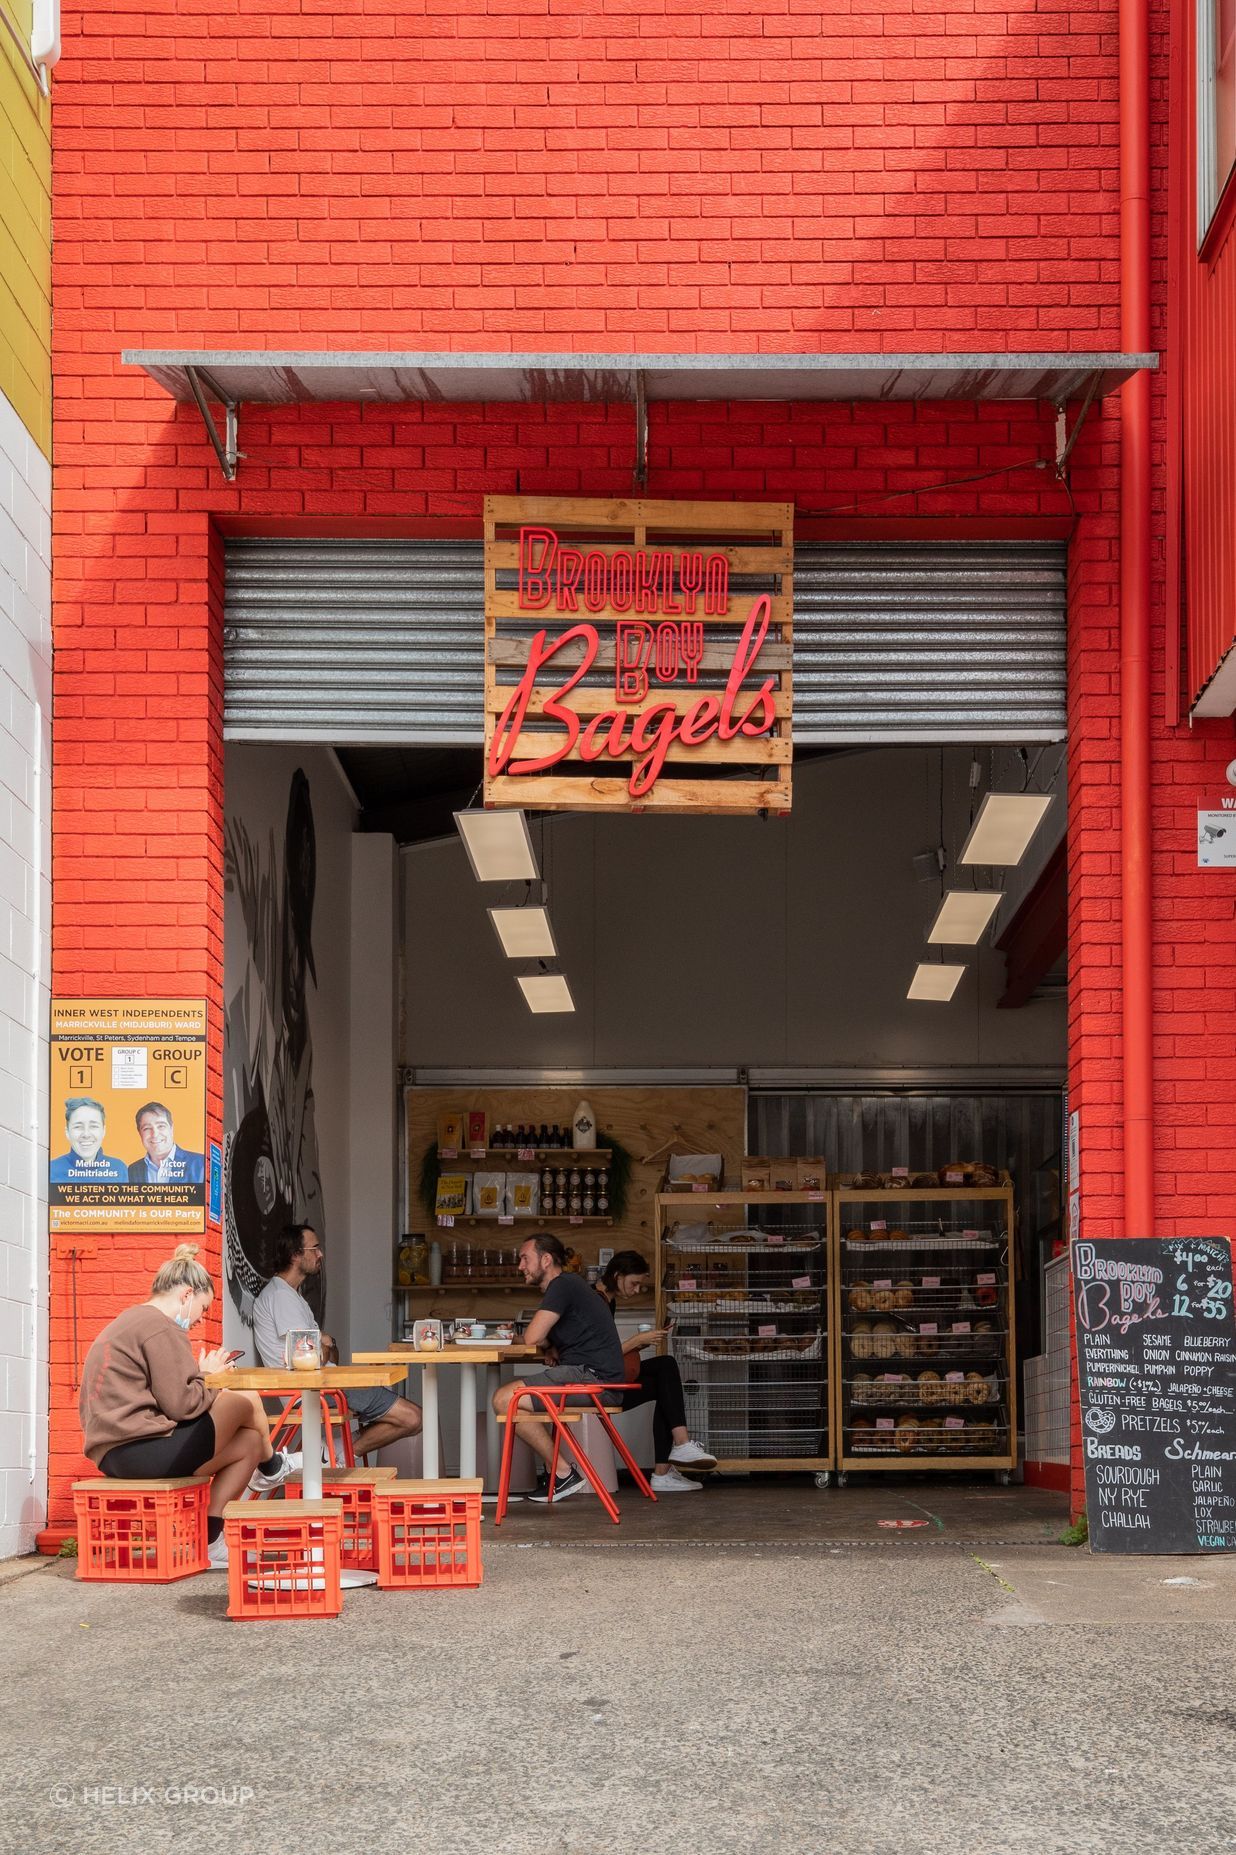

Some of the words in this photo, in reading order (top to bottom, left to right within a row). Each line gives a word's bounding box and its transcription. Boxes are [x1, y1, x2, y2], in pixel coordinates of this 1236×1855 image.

[616, 620, 703, 703] BOY
[488, 594, 775, 798] Bagels
[89, 1009, 119, 1017] WEST
[122, 1010, 203, 1018] INDEPENDENTS
[58, 1048, 104, 1061] VOTE
[152, 1050, 202, 1060] GROUP
[77, 1071, 83, 1083] 1
[170, 1070, 181, 1084] C
[140, 1186, 196, 1194] COMMUNITY,
[53, 1210, 70, 1218] The
[74, 1210, 136, 1218] COMMUNITY
[150, 1210, 172, 1218] OUR
[176, 1210, 201, 1219] Party
[1206, 1263, 1224, 1272] each
[1177, 1274, 1188, 1291] 6
[1207, 1274, 1232, 1298] $20
[1120, 1281, 1155, 1312] BOY
[1078, 1280, 1168, 1334] Bagels
[1171, 1294, 1193, 1318] 12
[1200, 1297, 1227, 1320] $35
[1084, 1334, 1110, 1345] PLAIN
[1143, 1334, 1172, 1346] SESAME
[1184, 1335, 1231, 1347] BLUEBERRY
[1085, 1348, 1128, 1359] EVERYTHING
[1144, 1349, 1170, 1360] ONION
[1176, 1350, 1212, 1362] CINNAMON
[1214, 1352, 1236, 1362] RAISIN
[1087, 1361, 1139, 1373] PUMPERNICKEL
[1144, 1364, 1176, 1375] PUMPKIN
[1184, 1365, 1215, 1377] POPPY
[1088, 1376, 1126, 1388] RAINBOW
[1168, 1383, 1201, 1393] JALAPEÑO
[1152, 1398, 1182, 1410] BAGELS
[1122, 1415, 1180, 1433] PRETZELS
[1087, 1437, 1142, 1460] BREADS
[1165, 1438, 1236, 1461] Schmear
[1096, 1465, 1160, 1485] SOURDOUGH
[1192, 1464, 1222, 1478] PLAIN
[1193, 1480, 1223, 1492] GARLIC
[1099, 1488, 1117, 1506] NY
[1122, 1488, 1150, 1508] RYE
[1193, 1495, 1235, 1507] JALAPEÑO
[1195, 1507, 1212, 1518] LOX
[1101, 1511, 1150, 1528] CHALLAH
[1196, 1520, 1236, 1533] STRAWBE
[1198, 1535, 1225, 1547] VEGAN
